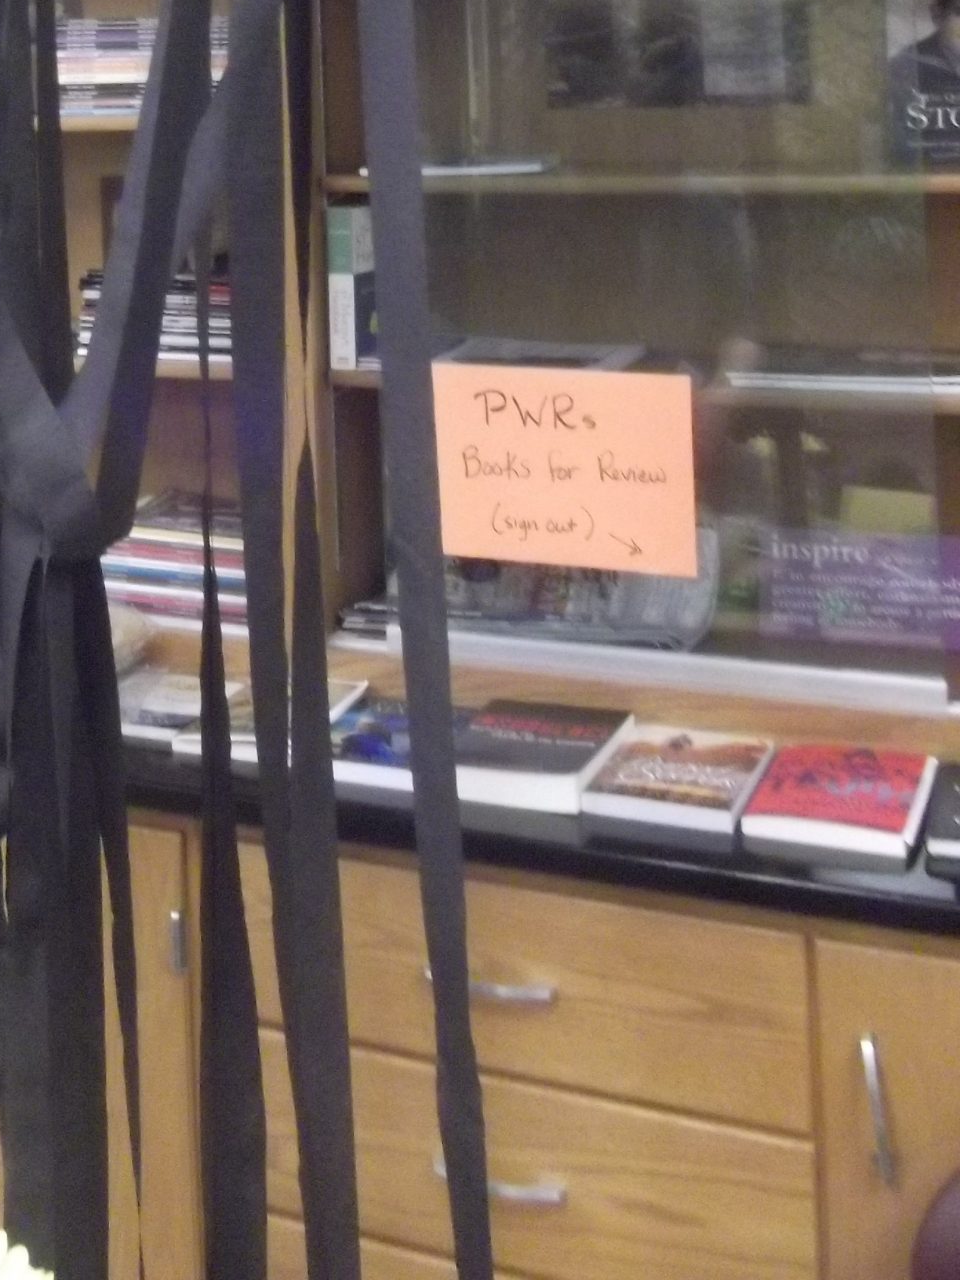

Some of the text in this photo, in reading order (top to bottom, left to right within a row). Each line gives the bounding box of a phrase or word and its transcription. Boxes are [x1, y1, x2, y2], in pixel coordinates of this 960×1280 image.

[462, 445, 668, 484] Books for Review
